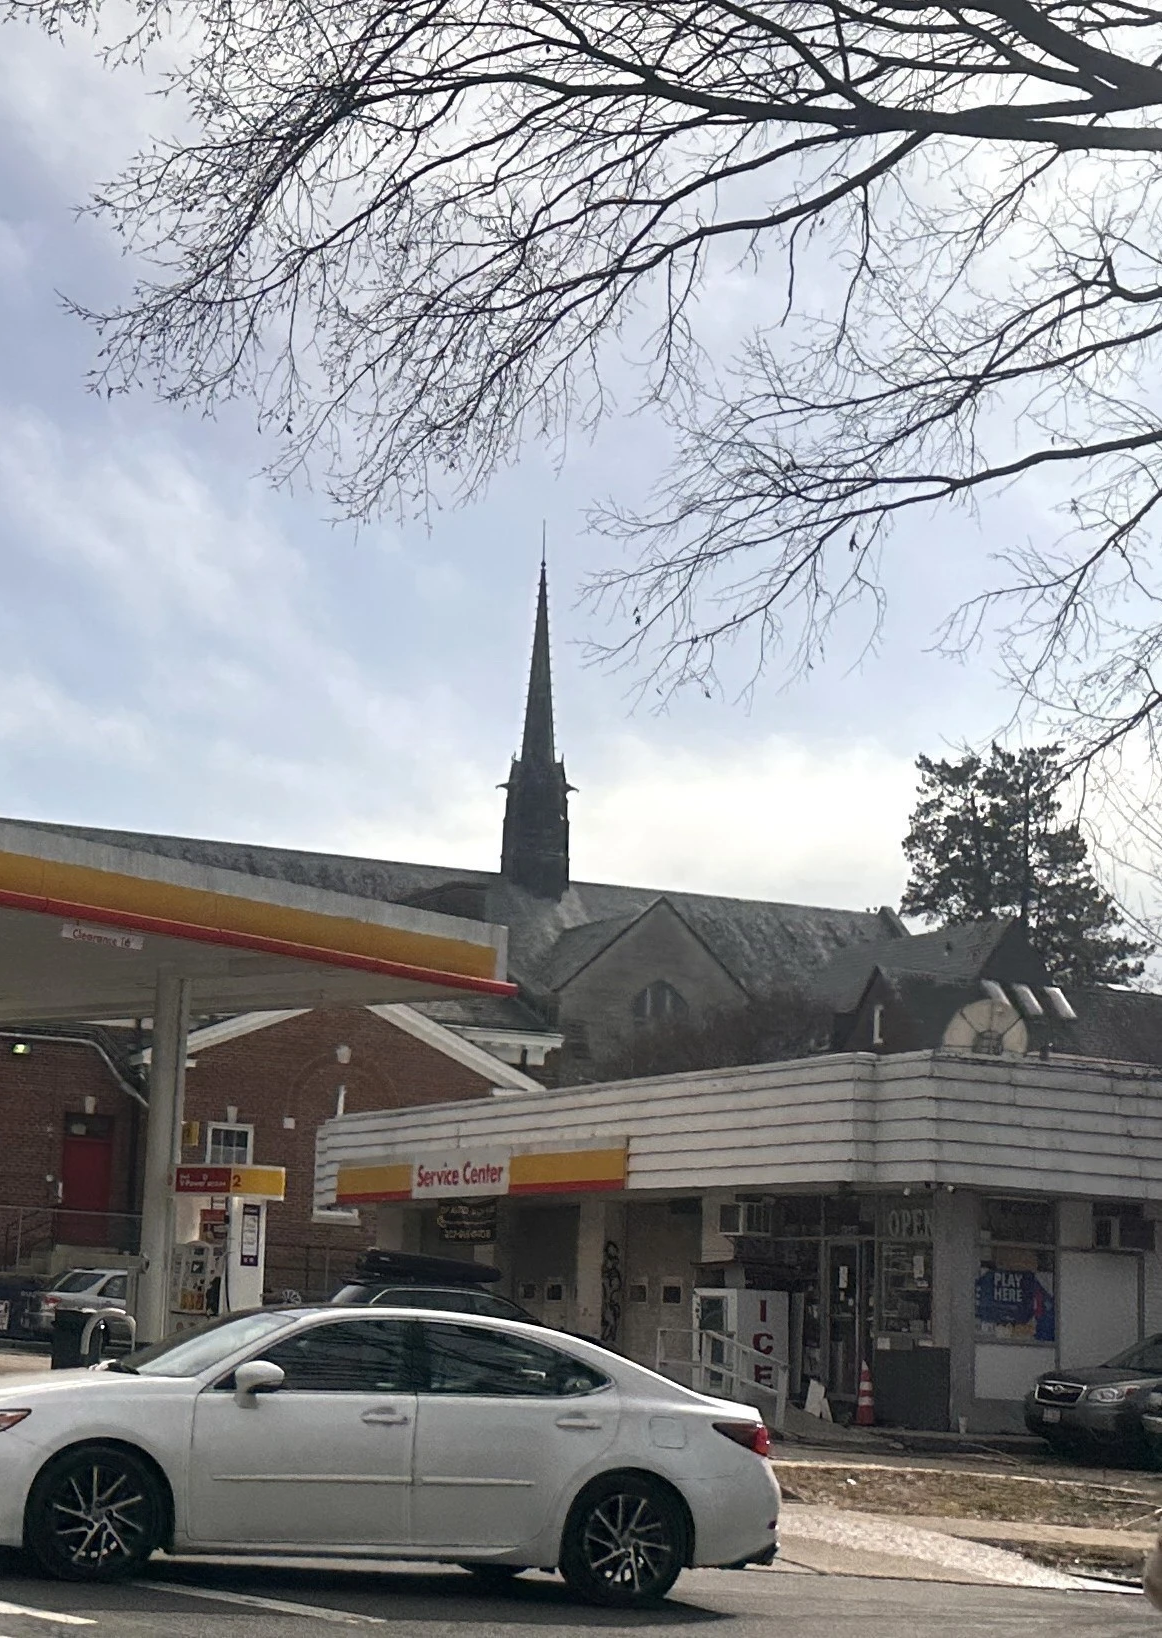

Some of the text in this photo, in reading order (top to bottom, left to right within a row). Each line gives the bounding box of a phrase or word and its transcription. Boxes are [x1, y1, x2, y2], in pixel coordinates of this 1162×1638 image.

[232, 1174, 242, 1188] 2
[417, 1161, 504, 1188] Service Center
[994, 1272, 1023, 1288] PLAY
[994, 1287, 1023, 1302] HERE
